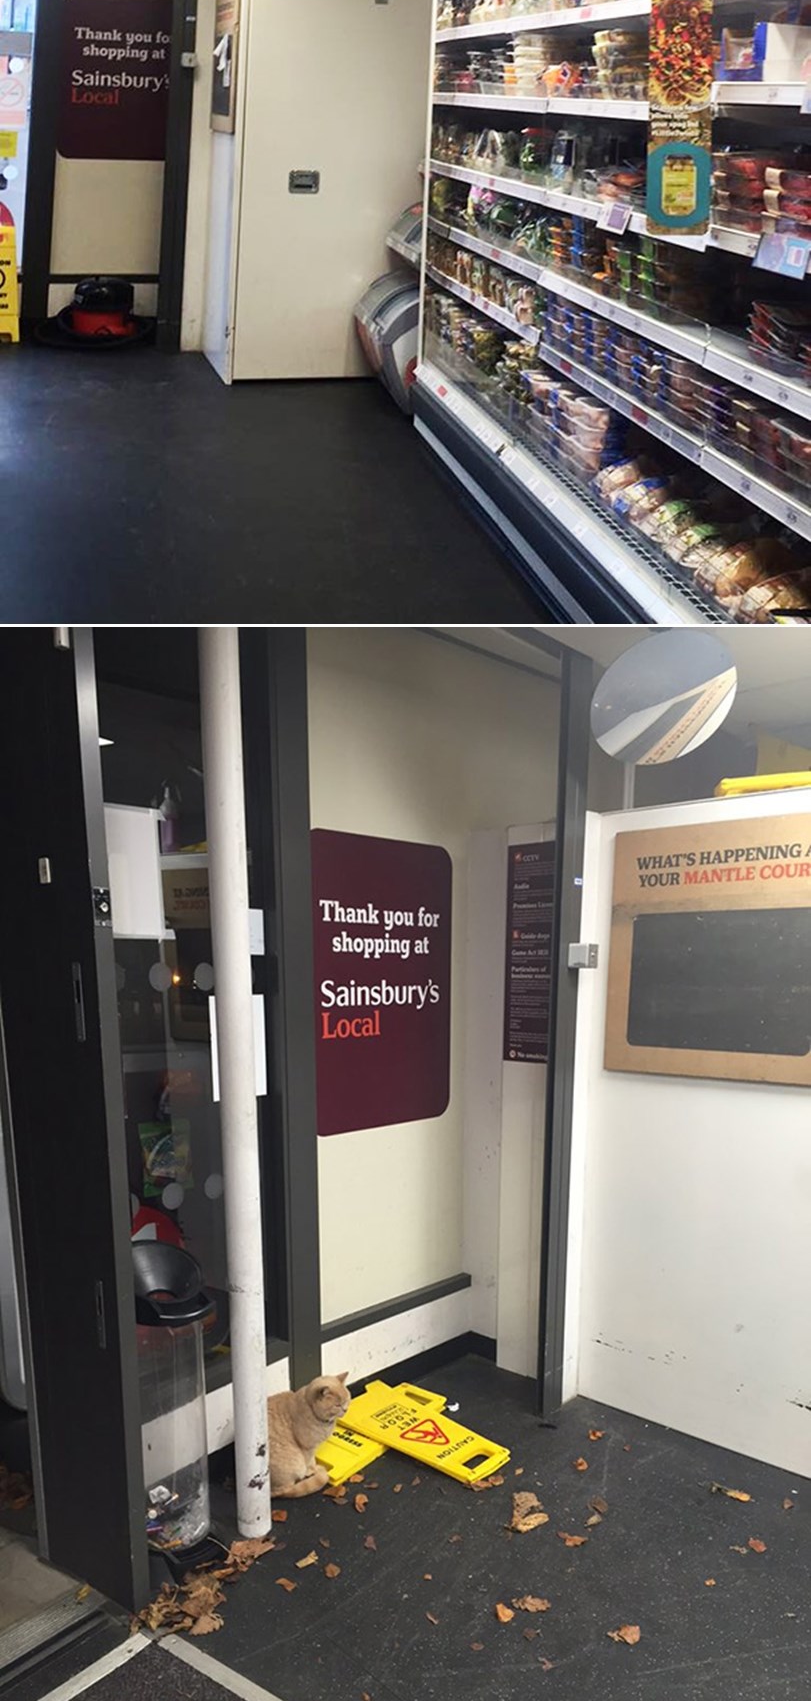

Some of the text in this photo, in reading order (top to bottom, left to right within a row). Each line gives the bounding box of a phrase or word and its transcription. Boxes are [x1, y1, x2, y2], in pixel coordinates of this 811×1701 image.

[75, 26, 170, 45] Thank you fo
[82, 45, 166, 62] shopping at
[71, 87, 120, 106] Local
[522, 853, 540, 862] CCTV
[637, 851, 697, 871] WHAT'S
[700, 843, 803, 866] HAPPENING
[639, 871, 681, 888] YOUR
[683, 865, 756, 886] MANTLE
[319, 899, 440, 931] Thank you for
[332, 931, 430, 960] shopping at
[320, 978, 440, 1010] Sainsbury's
[322, 1009, 381, 1040] Local
[379, 1408, 418, 1430] FLOOR
[397, 1416, 419, 1431] WET
[332, 1431, 364, 1449] OGRESS
[437, 1434, 475, 1460] CAUTION
